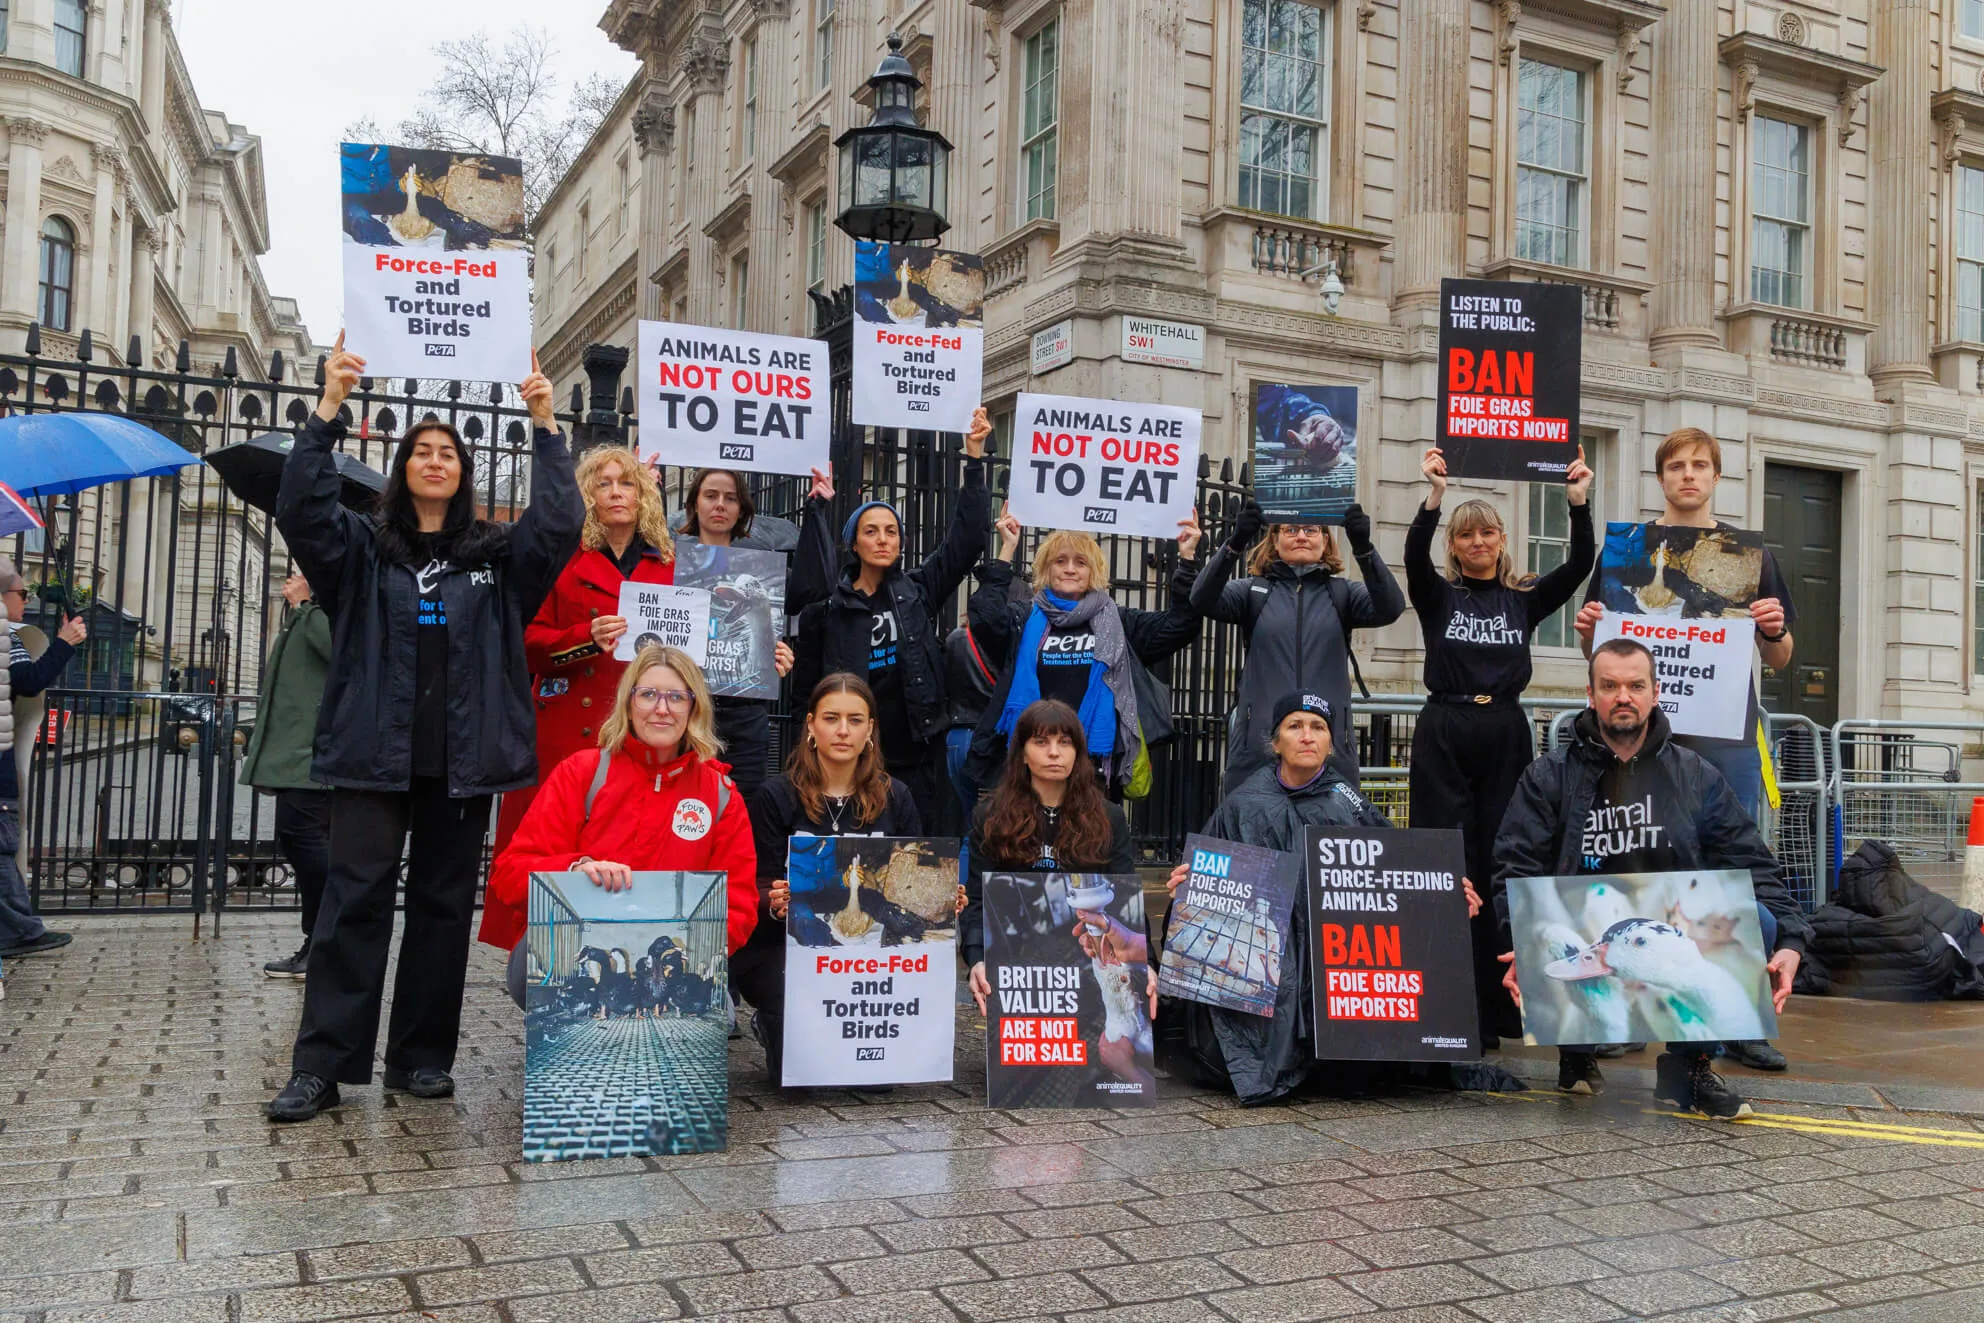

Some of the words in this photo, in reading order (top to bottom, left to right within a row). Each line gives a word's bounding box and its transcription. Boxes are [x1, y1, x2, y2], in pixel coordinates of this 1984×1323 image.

[376, 254, 497, 278] Force-Fed
[415, 279, 460, 296] and
[385, 296, 491, 318] Tortured
[1451, 296, 1500, 312] LISTEN
[1504, 299, 1521, 314] TO
[408, 318, 471, 337] Birds
[1129, 321, 1198, 341] WHITEHALL
[1451, 313, 1477, 328] THE
[1482, 316, 1536, 332] PUBLIC:
[876, 330, 961, 350] Force-Fed
[1036, 328, 1060, 347] DOWNING
[659, 338, 760, 365] ANIMALS
[768, 350, 811, 371] ARE
[904, 350, 935, 364] and
[1036, 343, 1054, 360] STREET
[1056, 338, 1068, 352] SW1
[1151, 356, 1189, 366] WESTMINSTER
[660, 362, 722, 390] NOT
[732, 370, 811, 400] OURS
[882, 363, 956, 382] Tortured
[1448, 348, 1534, 395] BAN
[896, 380, 940, 396] Birds
[660, 392, 718, 432] TO
[734, 400, 812, 440] EAT
[1450, 397, 1485, 414] FOIE
[1490, 398, 1530, 417] GRAS
[1033, 408, 1132, 434] ANIMALS
[1138, 418, 1183, 438] ARE
[1450, 418, 1518, 436] IMPORTS
[1524, 421, 1566, 440] NOW!
[1032, 432, 1092, 458] NOT
[1101, 438, 1180, 466] OURS
[1030, 460, 1085, 496] TO
[1099, 466, 1178, 504] EAT
[639, 592, 658, 604] BAN
[640, 606, 660, 618] FOIE
[664, 608, 690, 620] GRAS
[1451, 610, 1507, 631] animal
[648, 620, 691, 634] IMPORTS
[1445, 625, 1522, 644] EQUALITY
[1621, 621, 1726, 644] Force-Fed
[666, 634, 689, 646] NOW
[708, 640, 740, 656] GRAS
[1652, 644, 1690, 659] and
[1658, 661, 1715, 680] tured
[1319, 838, 1384, 866] STOP
[1193, 852, 1230, 876] BAN
[1190, 873, 1215, 891] FOIE
[1218, 880, 1252, 899] GRAS
[1320, 868, 1454, 891] FORCE-FEEDING
[1186, 890, 1246, 915] IMPORTS!
[1322, 892, 1398, 912] ANIMALS
[1322, 924, 1402, 966] BAN
[816, 954, 928, 974] Force-Fed
[851, 977, 892, 995] and
[998, 966, 1080, 989] BRITISH
[1328, 972, 1368, 992] FOIE
[1374, 973, 1420, 994] GRAS
[822, 998, 920, 1018] Tortured
[998, 990, 1078, 1014] VALUES
[1330, 996, 1415, 1018] IMPORTS!
[842, 1021, 900, 1040] Birds
[1002, 1020, 1036, 1039] ARE
[1041, 1020, 1074, 1039] NOT
[1003, 1043, 1036, 1062] FOR
[1040, 1044, 1084, 1062] SALE
